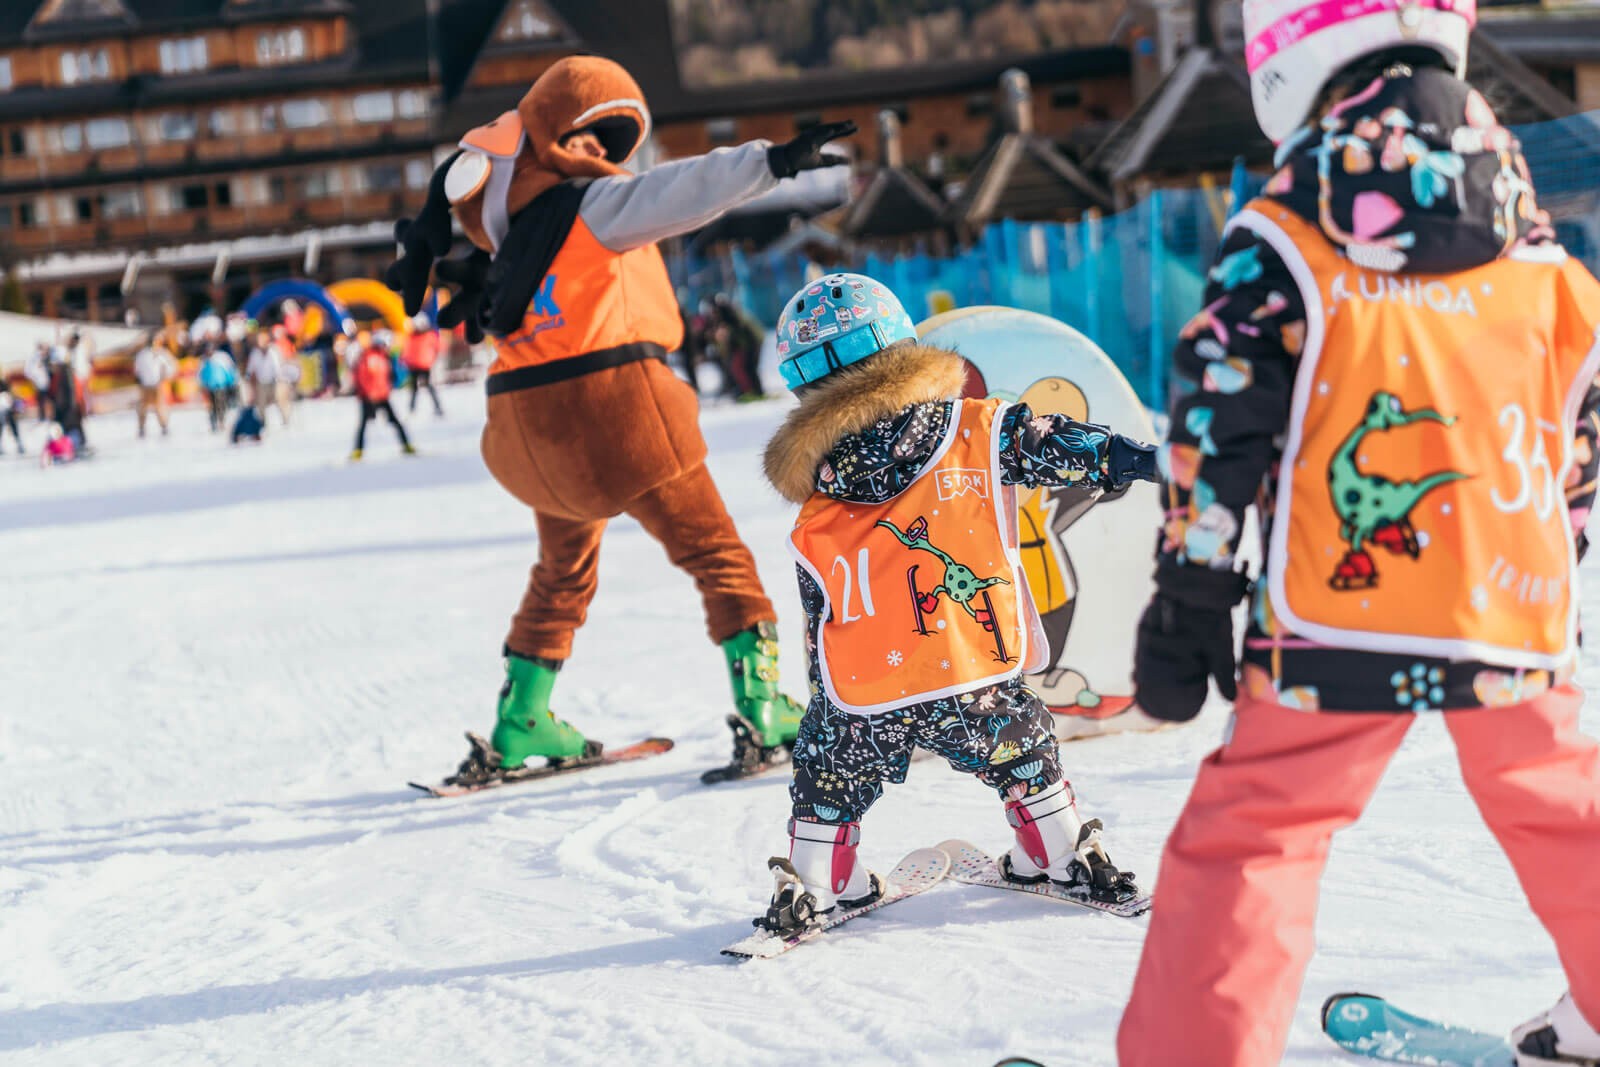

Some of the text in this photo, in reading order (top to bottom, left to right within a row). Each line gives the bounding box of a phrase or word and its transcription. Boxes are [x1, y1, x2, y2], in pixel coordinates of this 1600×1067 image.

[1358, 275, 1476, 315] UNIQA
[942, 474, 983, 489] STOK
[1491, 404, 1557, 521] 35
[831, 547, 876, 625] 21
